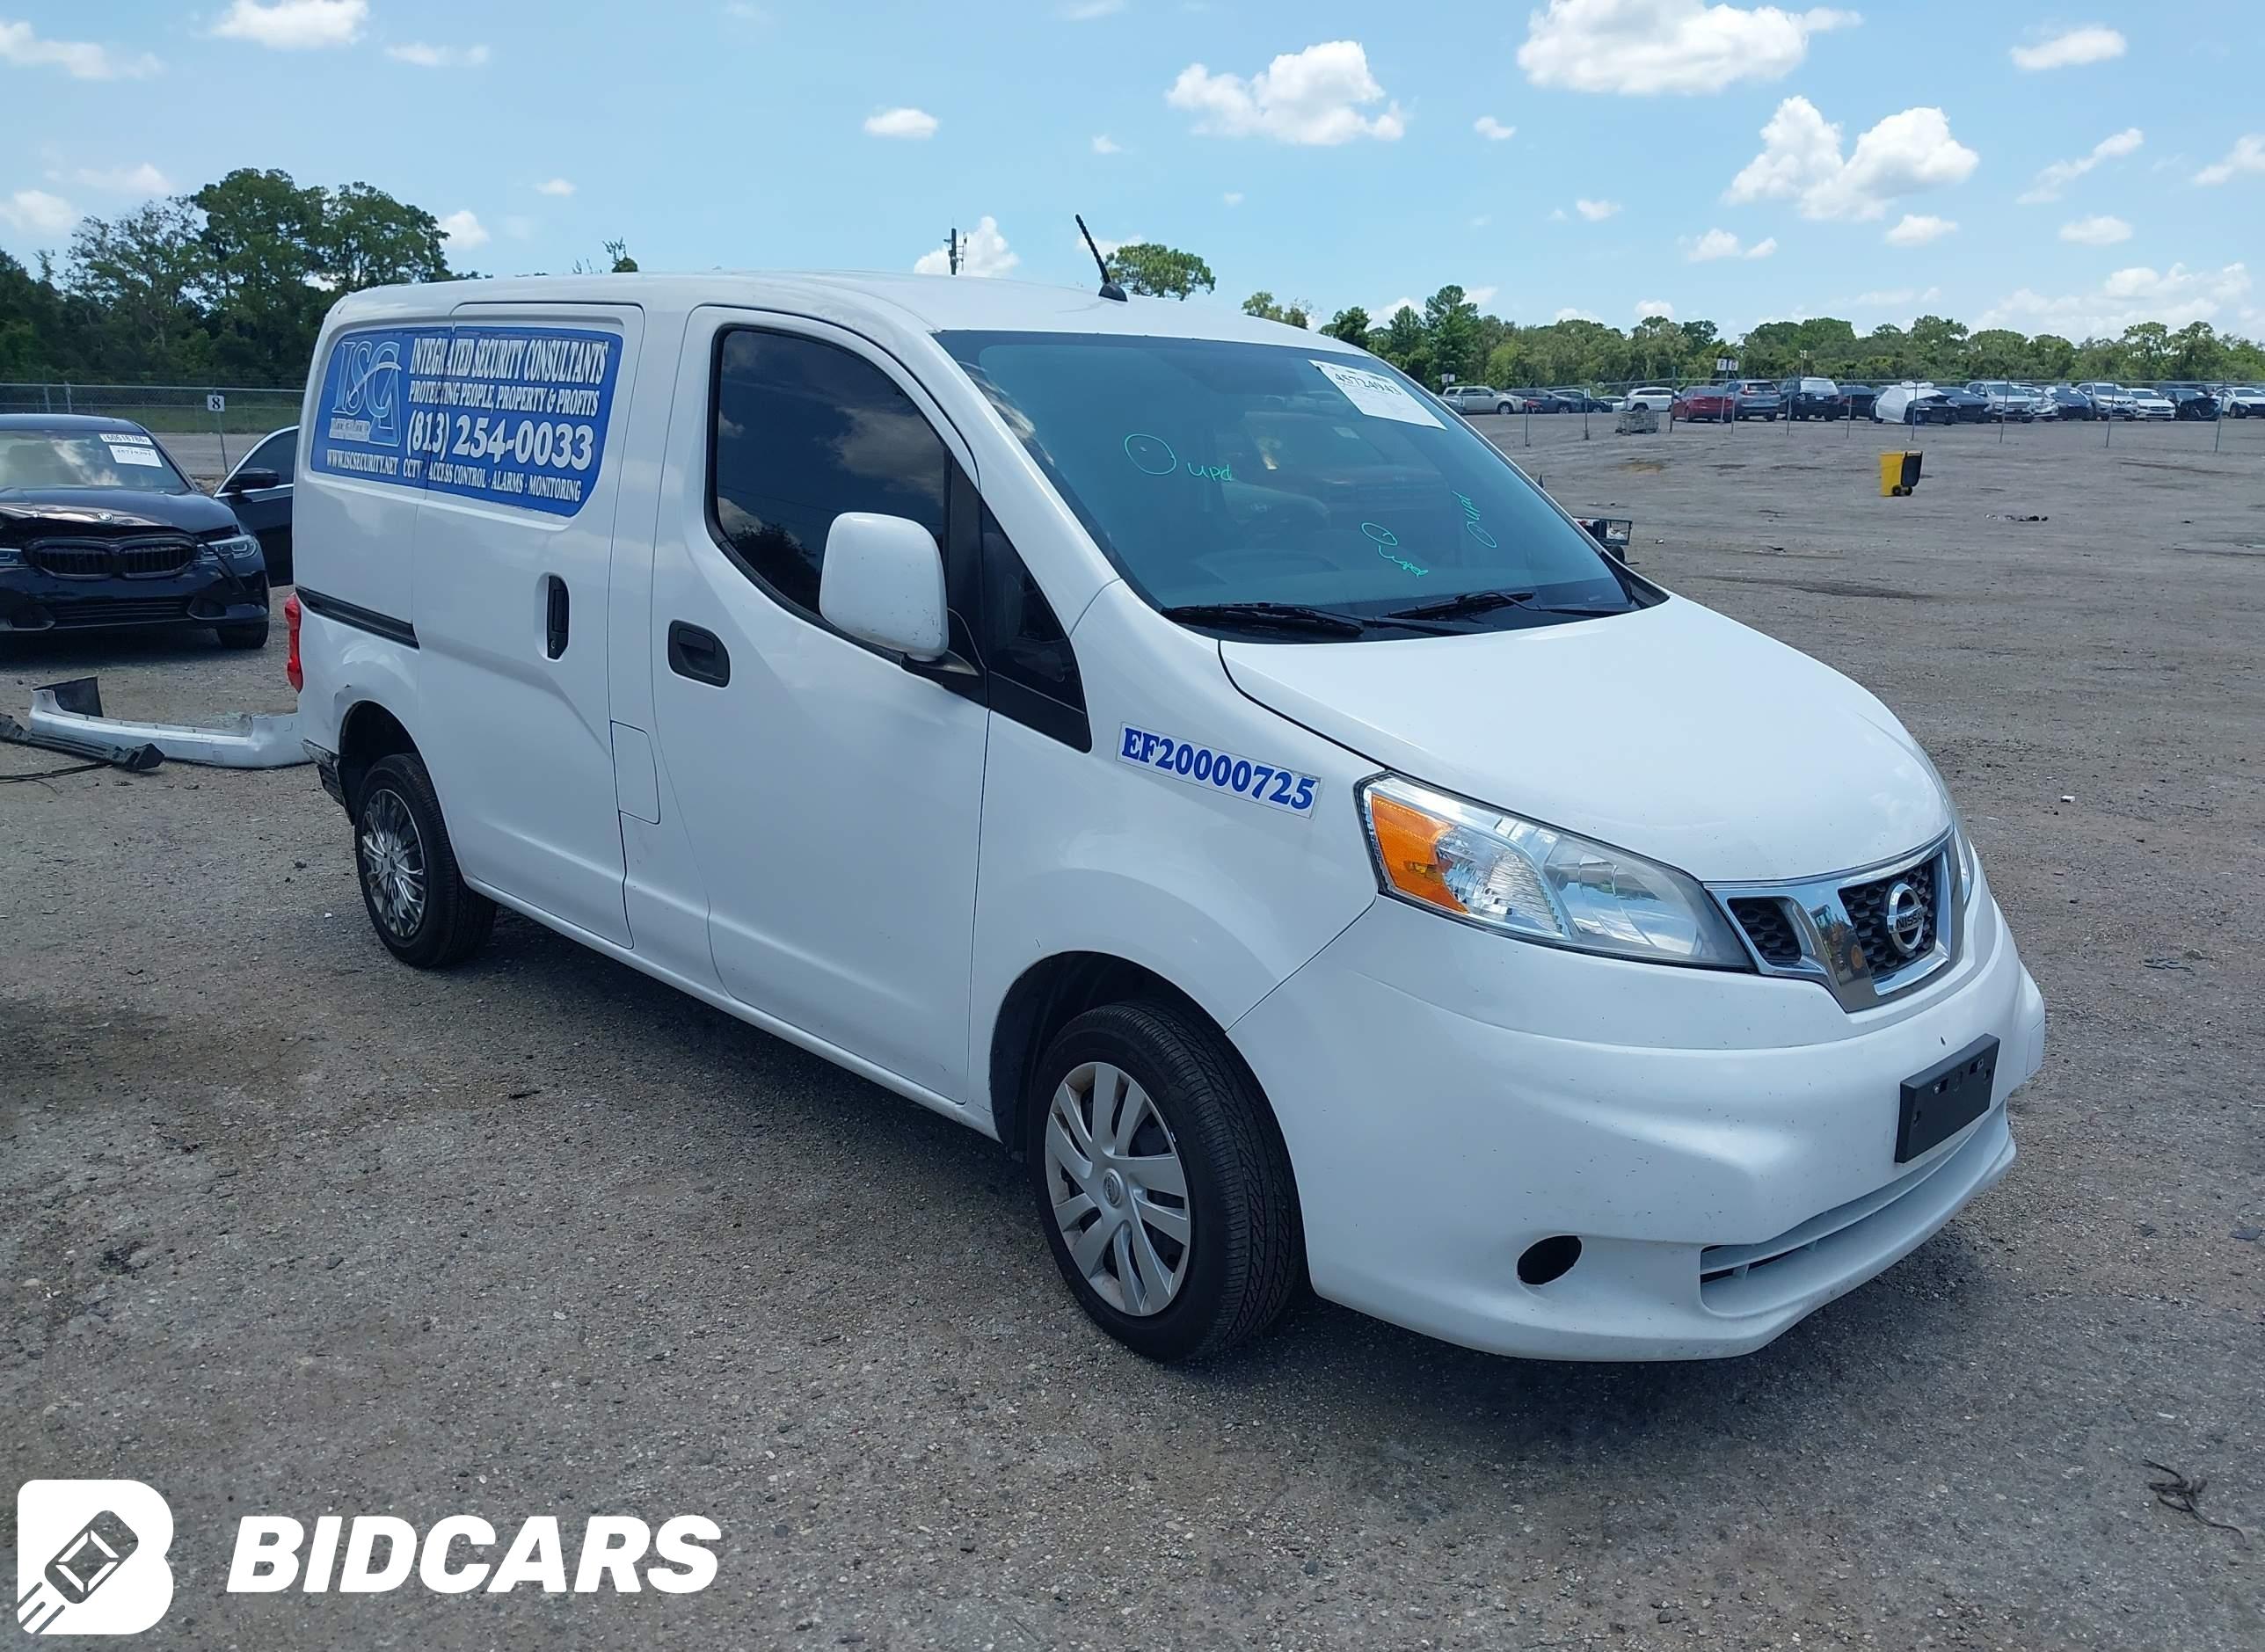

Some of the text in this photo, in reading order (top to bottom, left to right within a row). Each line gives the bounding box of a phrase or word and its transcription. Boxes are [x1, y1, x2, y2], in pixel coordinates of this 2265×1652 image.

[471, 338, 528, 380] SECURITY
[523, 339, 608, 385] CONSULTANTS
[212, 397, 221, 410] 8
[408, 380, 601, 417] PROTECTING PEOPLE, PROPERTY & PROFITS
[326, 449, 399, 476] WWW.ISCSECURITY.NET
[407, 410, 450, 461] (813)
[452, 414, 594, 471] 254-0033
[403, 458, 582, 503] CCTV ACCESS CONTROL ALARMS MONITORING
[1121, 727, 1316, 810] EF20000725
